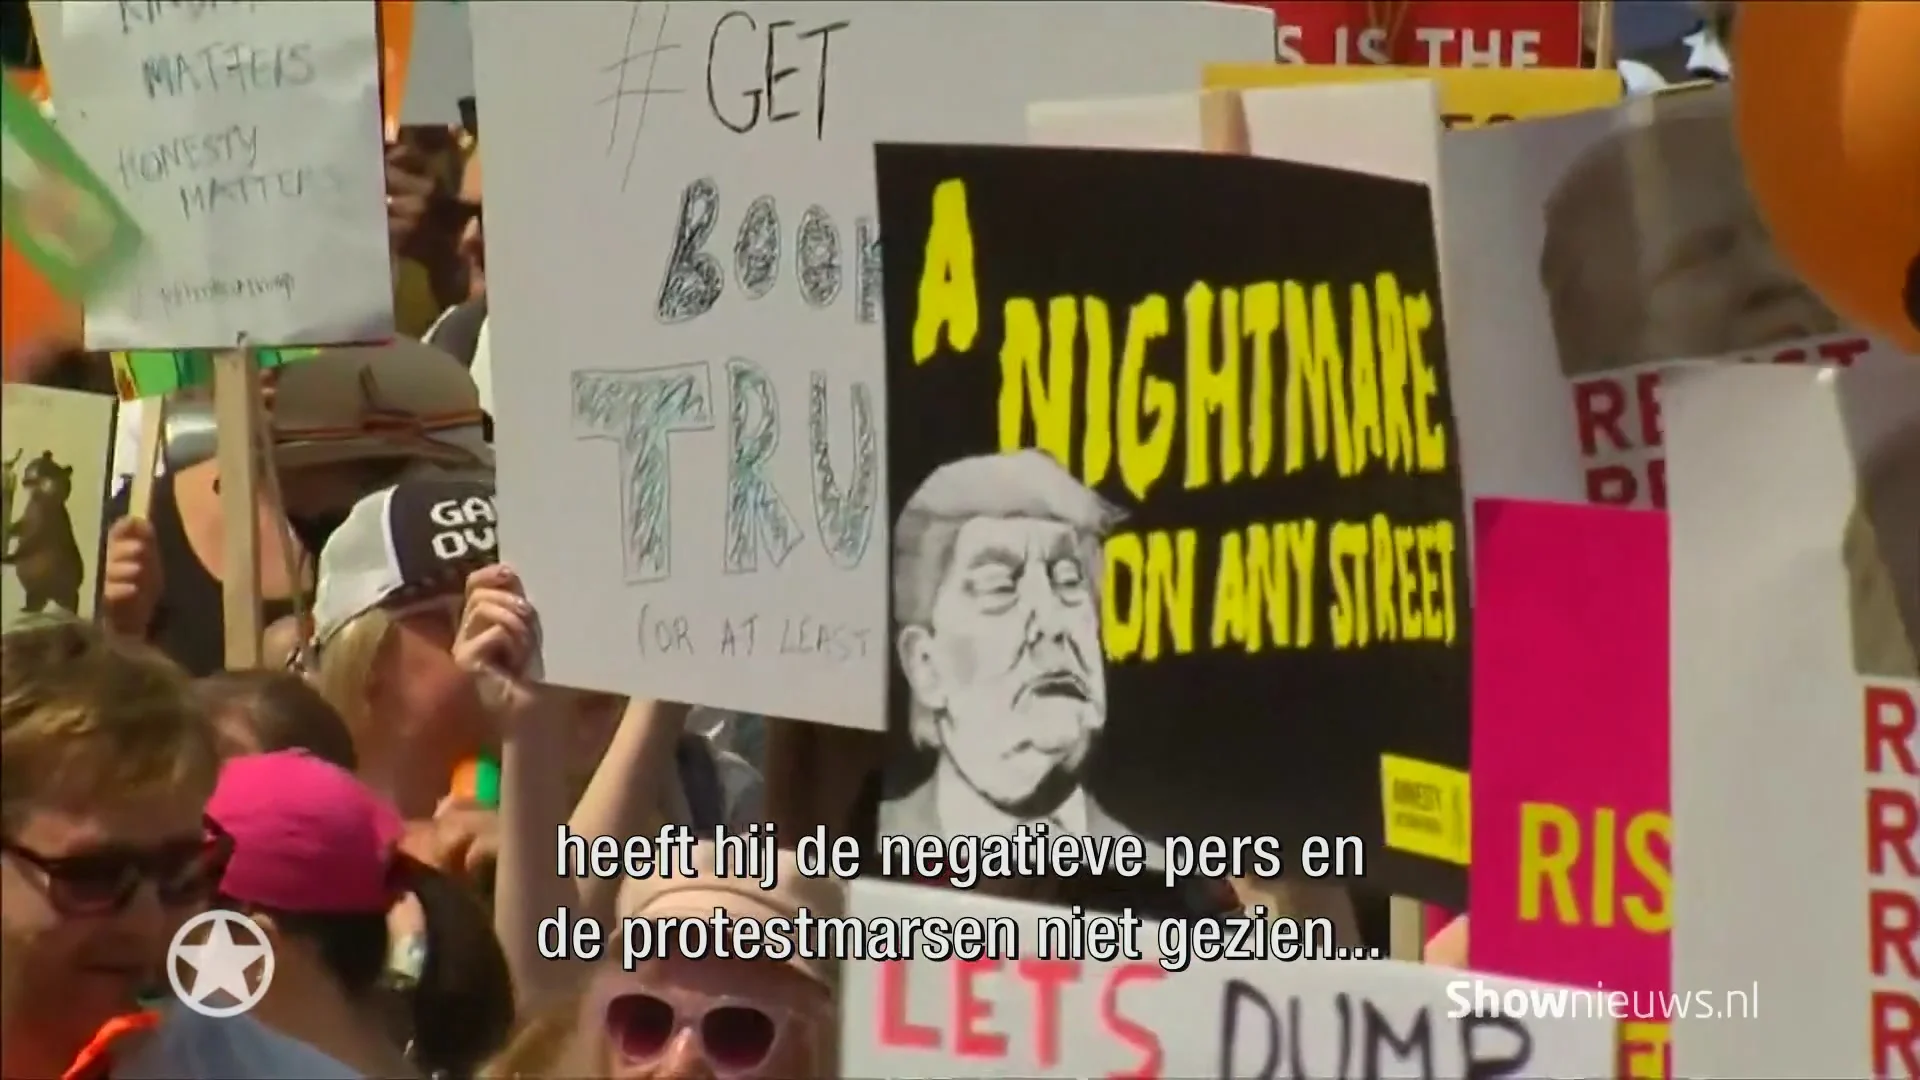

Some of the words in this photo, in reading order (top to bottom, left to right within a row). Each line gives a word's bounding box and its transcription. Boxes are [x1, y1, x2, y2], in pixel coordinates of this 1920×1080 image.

[1335, 26, 1391, 66] IS
[1415, 28, 1541, 69] THE
[117, 124, 257, 191] HONESTY
[912, 178, 978, 364] A
[998, 271, 1446, 500] NIGHTMARE
[430, 496, 497, 527] GA
[637, 603, 694, 659] (OR
[721, 614, 758, 659] AT
[779, 617, 872, 658] LEAST
[1102, 528, 1196, 663] ON
[1211, 518, 1317, 653] ANY
[1329, 512, 1457, 649] STREET
[1518, 802, 1672, 932] RIS
[881, 951, 1169, 1078] LETS
[1219, 978, 1535, 1078] DUMP
